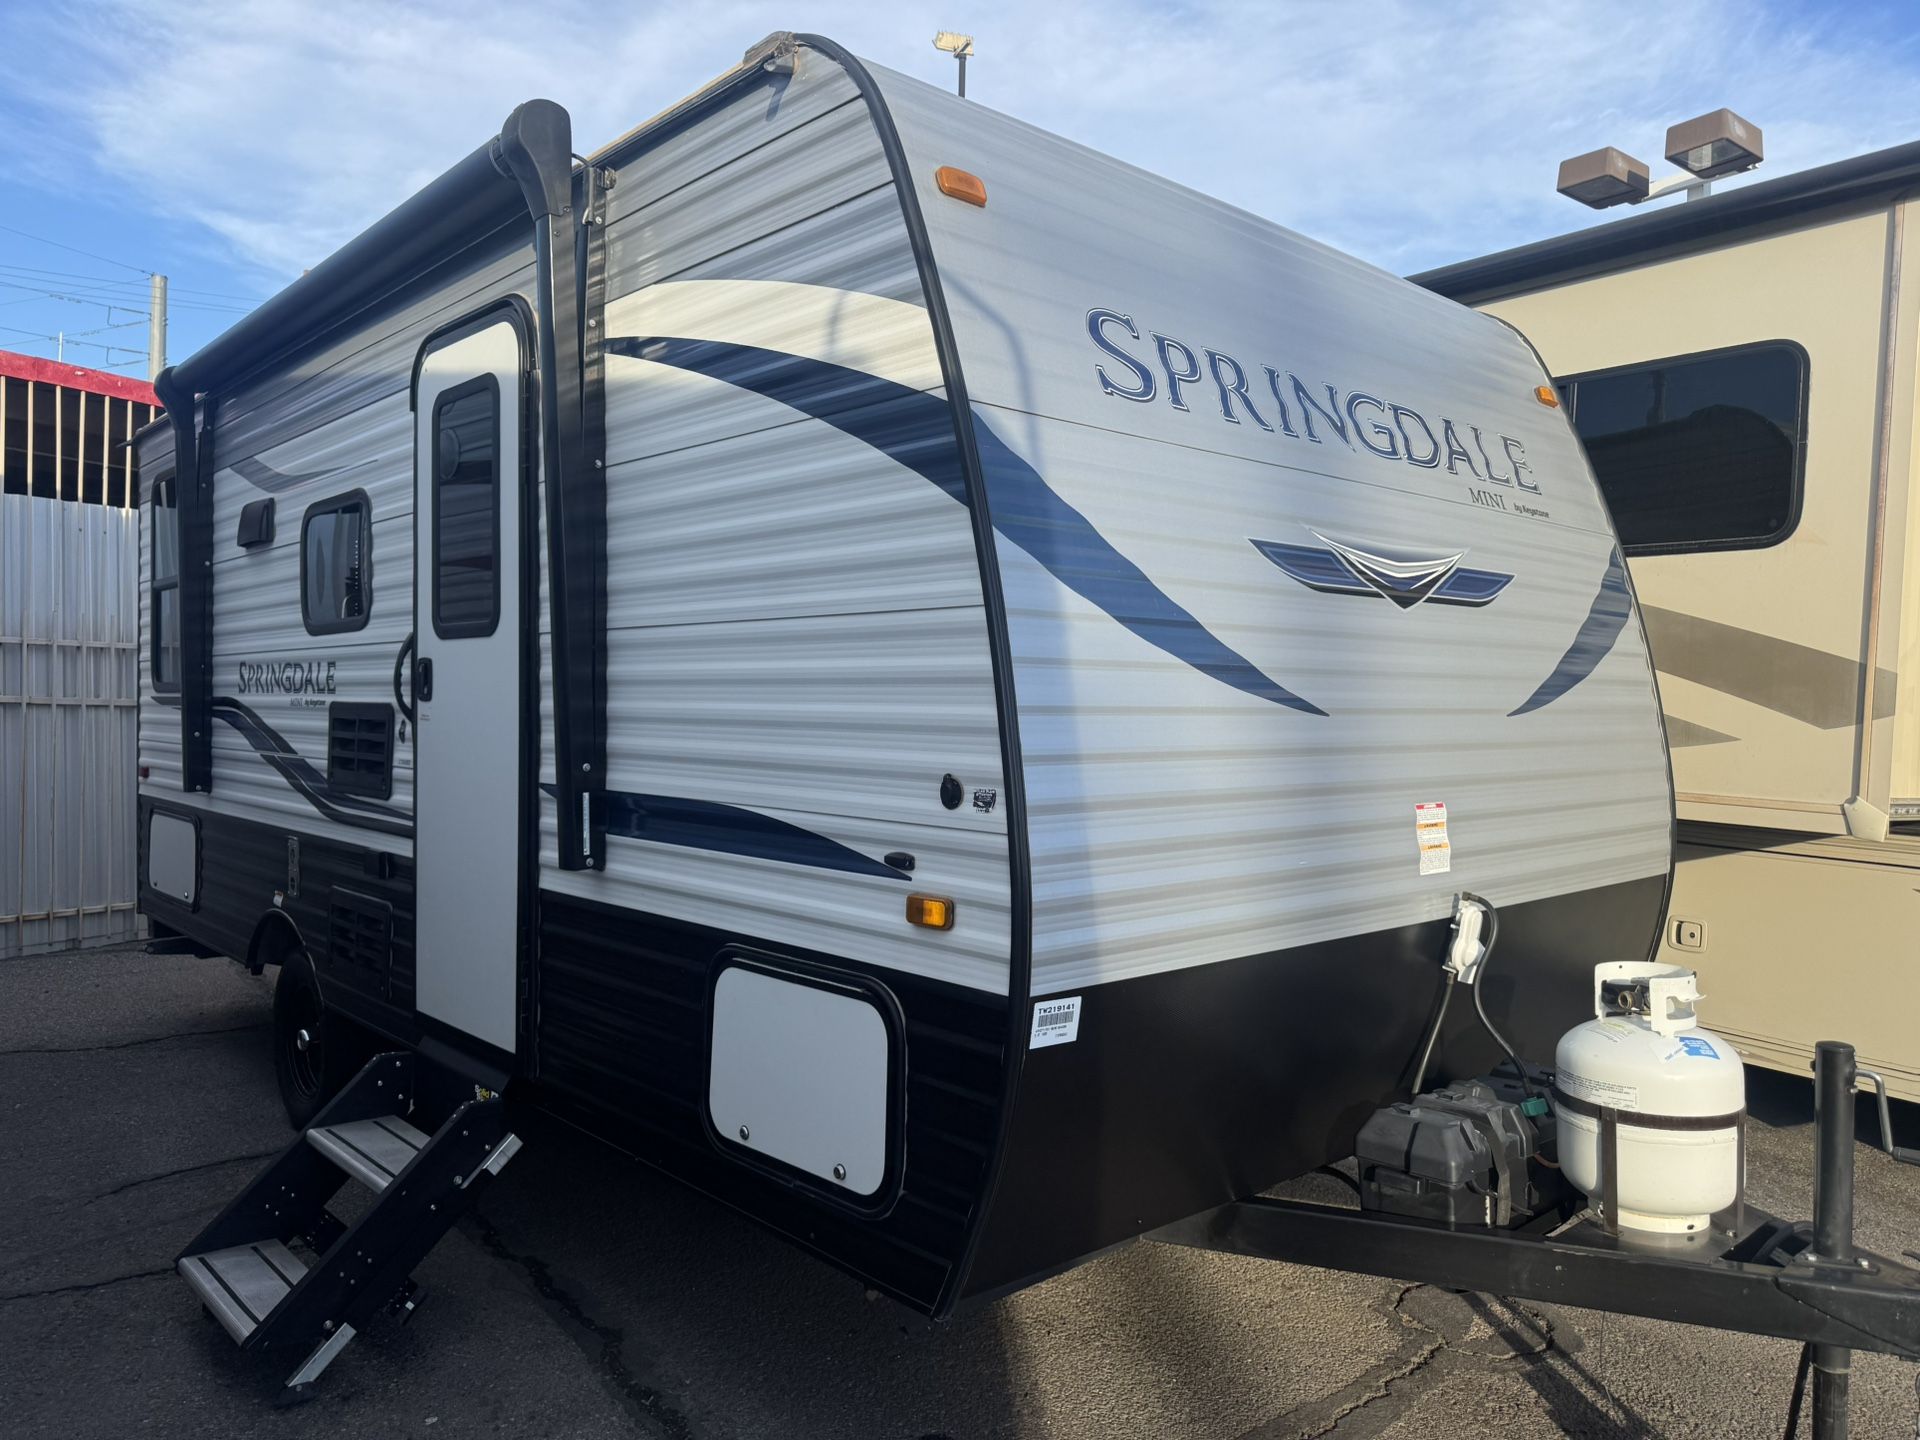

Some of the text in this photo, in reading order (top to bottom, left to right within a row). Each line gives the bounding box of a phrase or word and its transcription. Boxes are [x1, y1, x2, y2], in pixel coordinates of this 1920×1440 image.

[1086, 307, 1542, 495] SPRINGDALE
[1469, 487, 1507, 510] MINI
[238, 661, 336, 694] SPRINGDALE
[1038, 1003, 1075, 1015] TW219141
